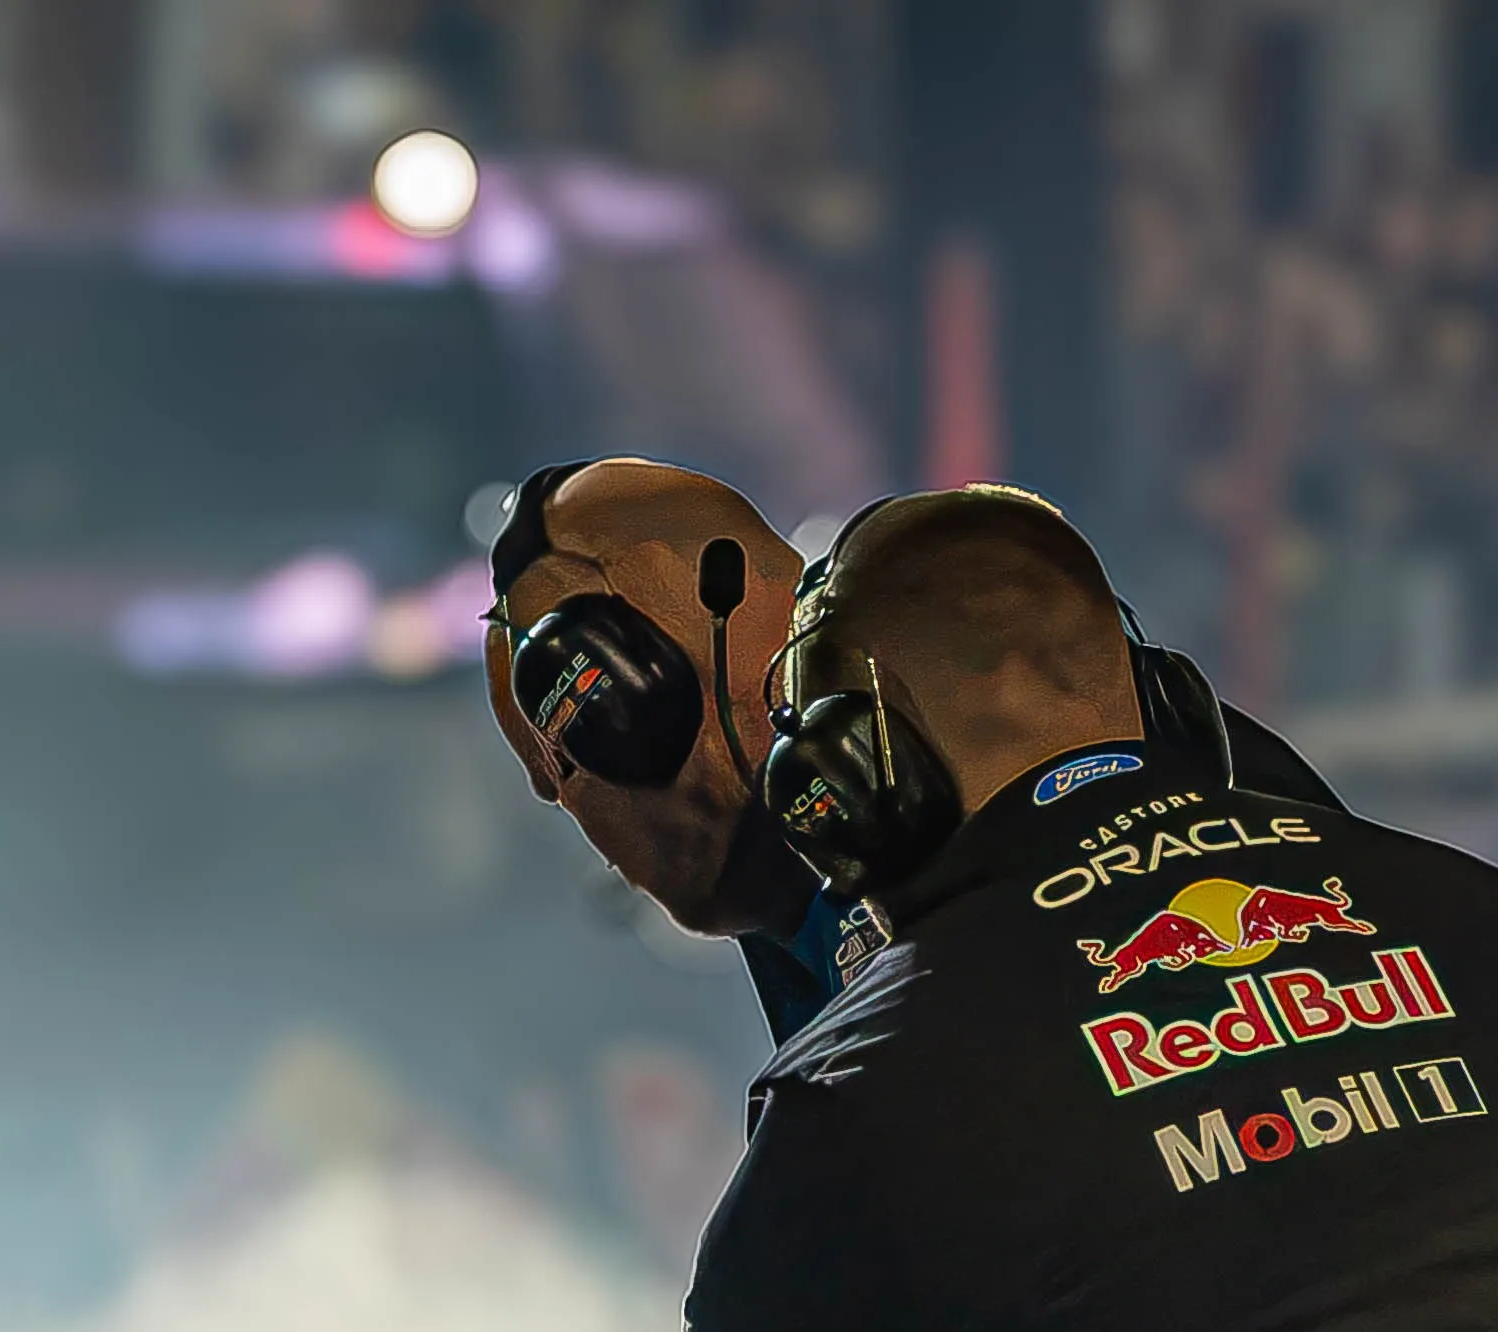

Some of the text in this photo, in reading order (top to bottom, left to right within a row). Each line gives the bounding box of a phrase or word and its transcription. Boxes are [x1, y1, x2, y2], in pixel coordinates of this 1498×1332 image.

[1049, 756, 1130, 797] Ford
[1079, 792, 1204, 850] CASTORE
[1032, 817, 1321, 910] ORACLE
[1080, 946, 1456, 1097] Red Bull
[1153, 1070, 1400, 1193] Mobil
